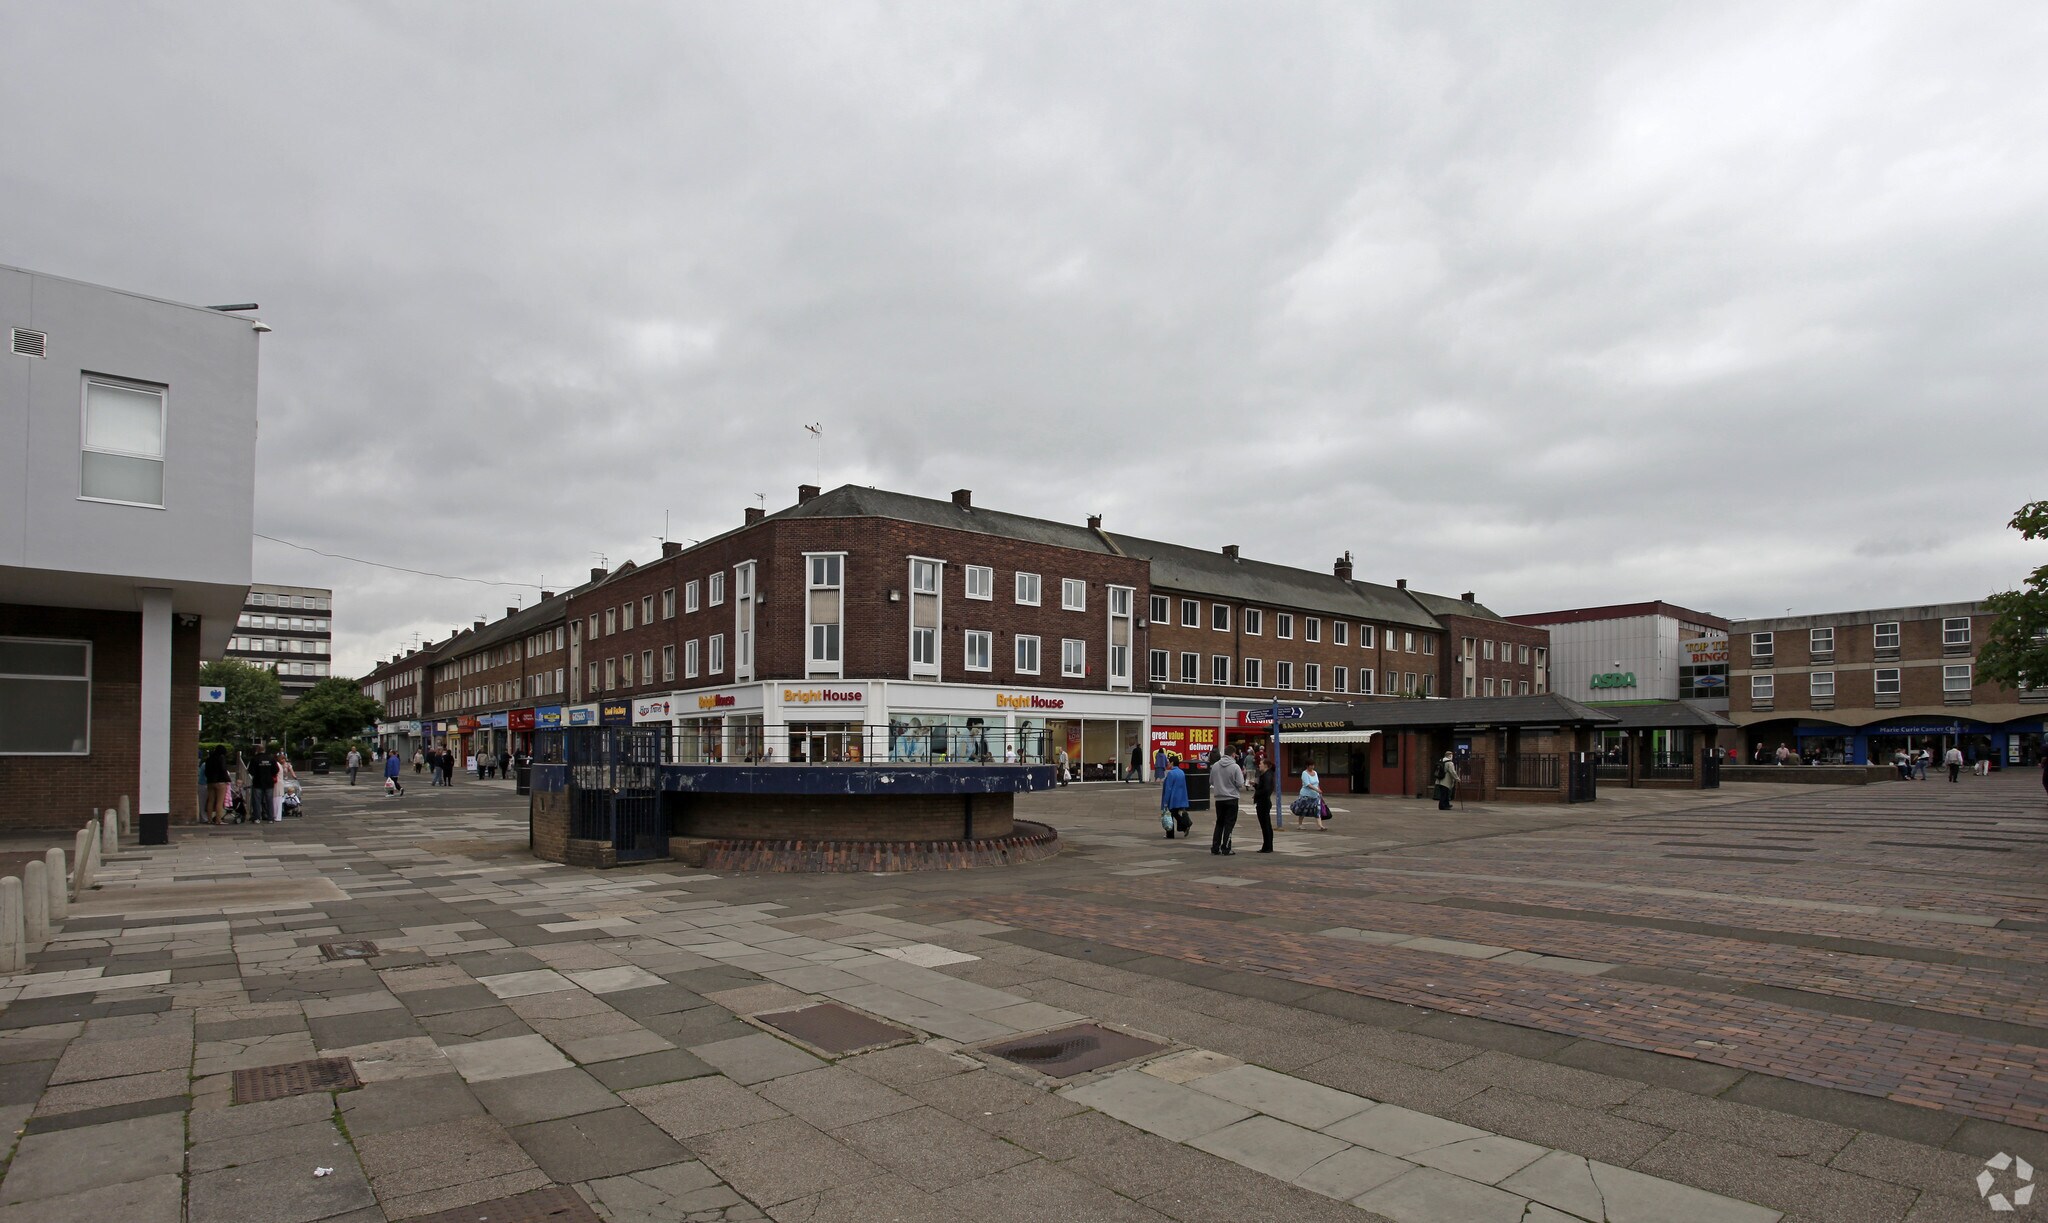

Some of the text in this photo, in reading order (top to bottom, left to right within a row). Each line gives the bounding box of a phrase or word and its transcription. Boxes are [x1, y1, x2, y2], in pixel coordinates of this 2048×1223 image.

[1685, 641, 1728, 652] TOP TE
[1692, 652, 1728, 663] BINGO
[1590, 672, 1637, 689] ASDA
[1152, 731, 1184, 740] great value
[1189, 743, 1213, 751] delivery
